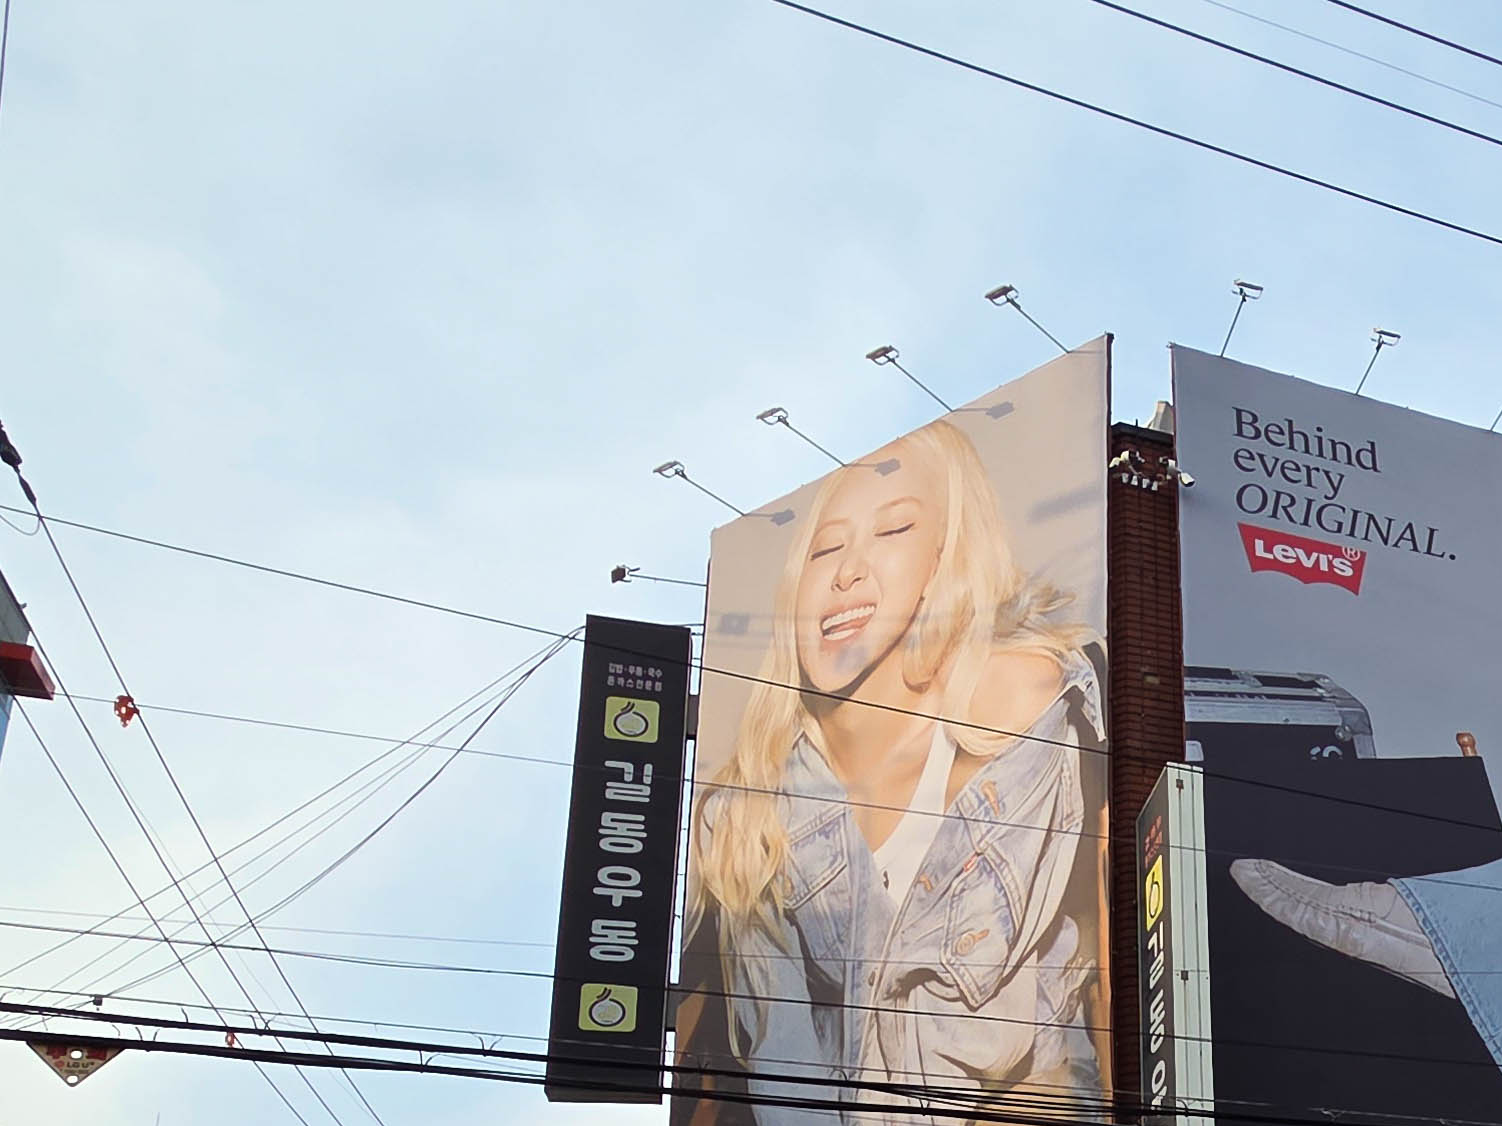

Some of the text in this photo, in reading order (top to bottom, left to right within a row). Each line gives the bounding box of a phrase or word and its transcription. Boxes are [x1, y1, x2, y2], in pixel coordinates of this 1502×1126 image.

[1232, 406, 1382, 474] Behind
[1233, 447, 1345, 500] every
[1235, 483, 1457, 562] ORIGINAL.
[588, 760, 653, 963] 길동우동
